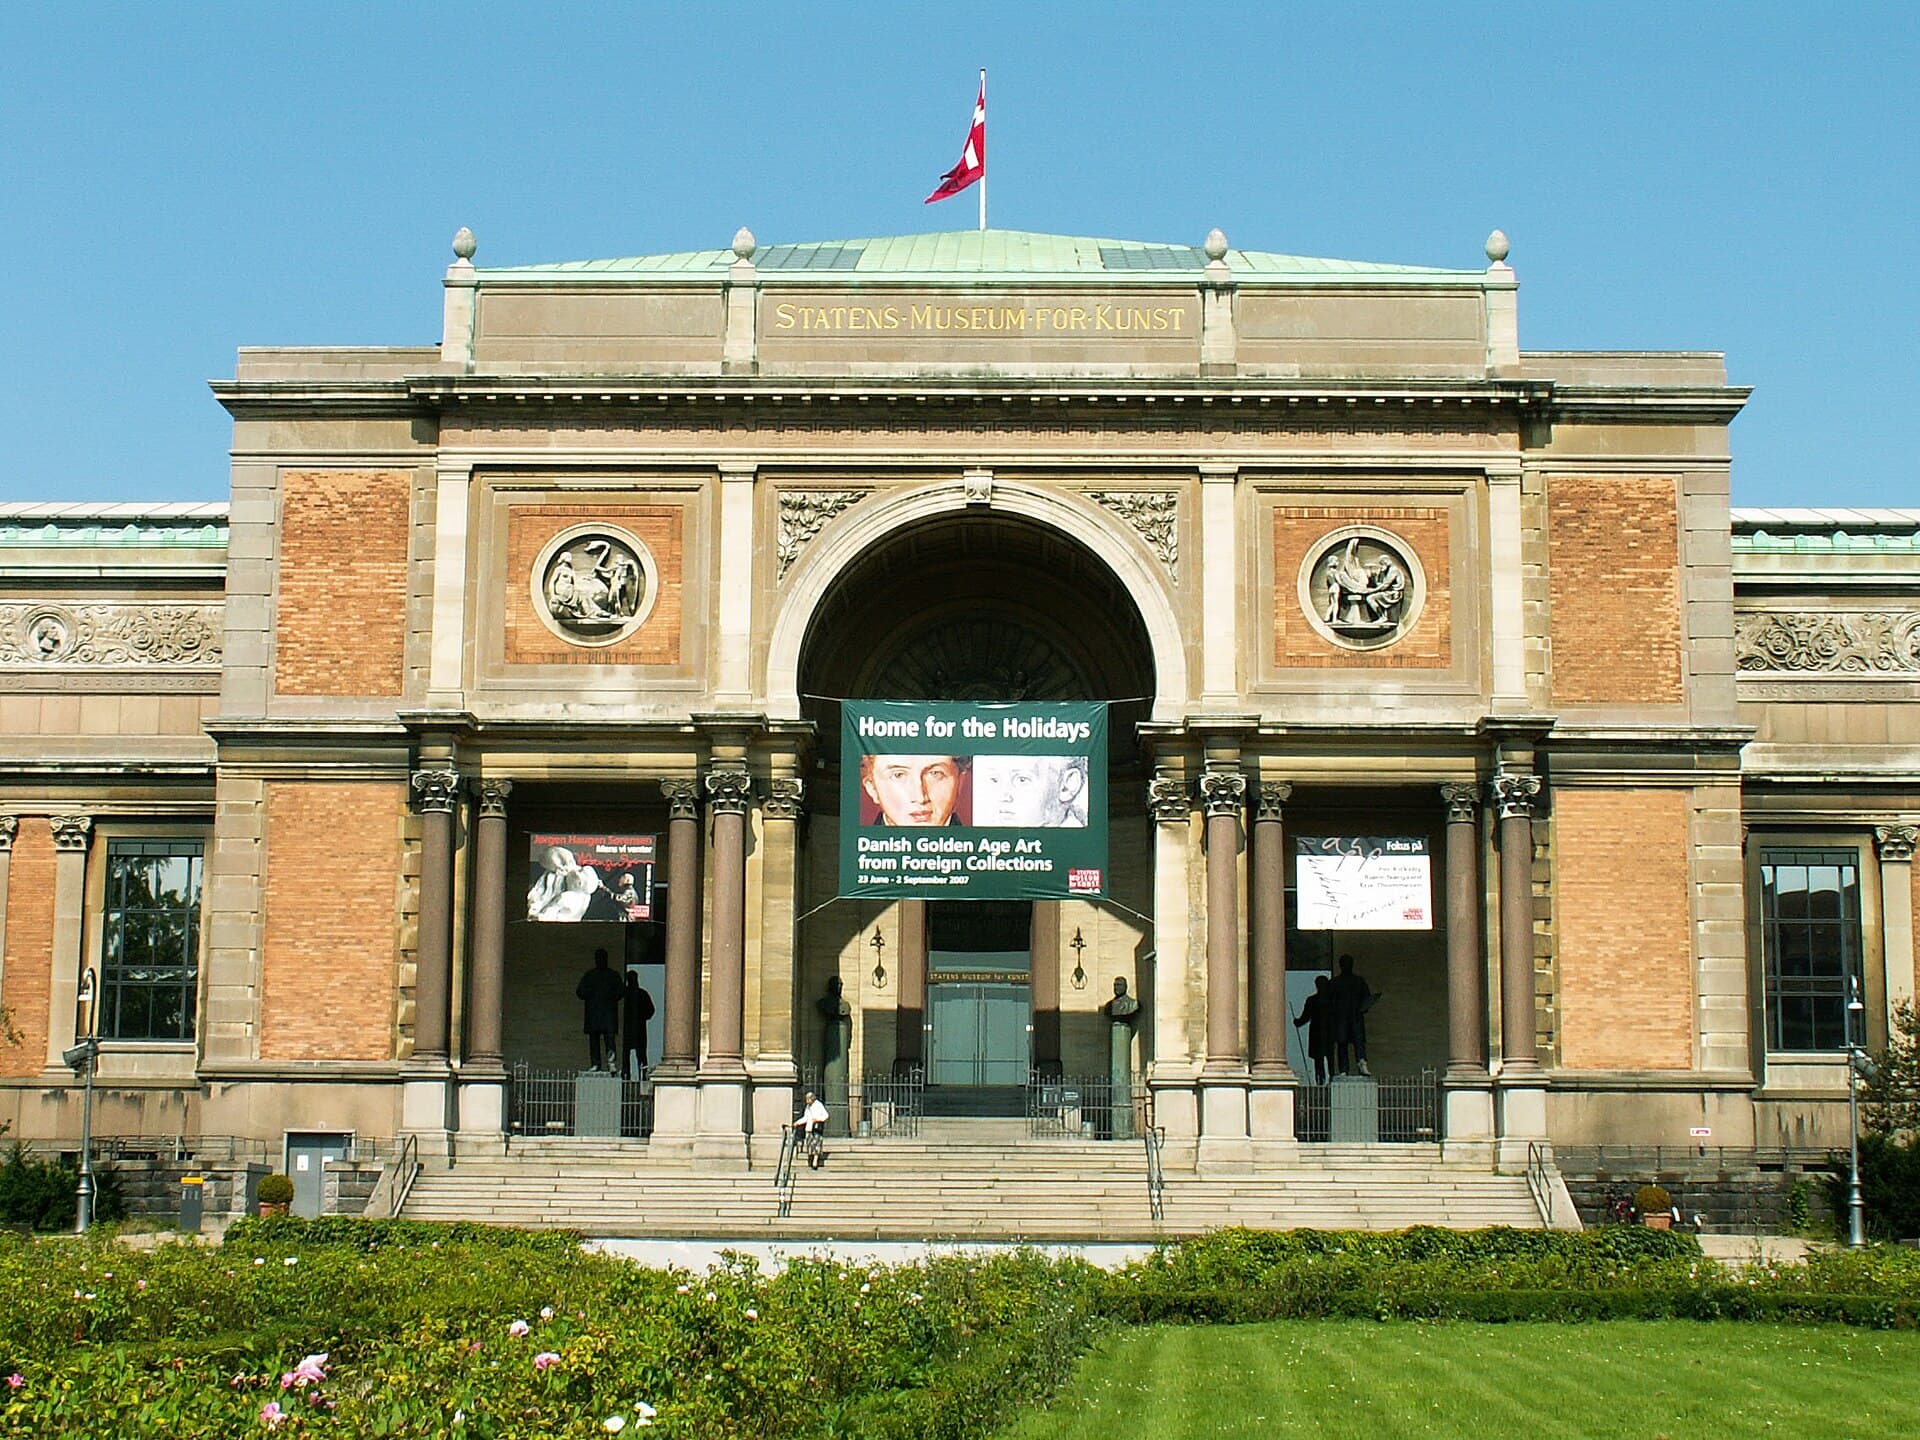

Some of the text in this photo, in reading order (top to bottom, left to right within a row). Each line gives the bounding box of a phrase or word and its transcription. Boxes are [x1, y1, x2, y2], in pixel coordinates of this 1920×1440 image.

[775, 303, 1186, 331] STATENS MUSEUM FOR KUNST
[858, 716, 1091, 743] Home for the Holidays
[857, 837, 1042, 857] Danish Golden Age Art
[1386, 840, 1410, 851] Fokus
[858, 855, 1053, 874] from Foreign Collections
[858, 875, 869, 884] 23
[870, 875, 889, 884] June
[896, 875, 902, 884] 2
[903, 875, 948, 885] September
[949, 875, 969, 884] 2007
